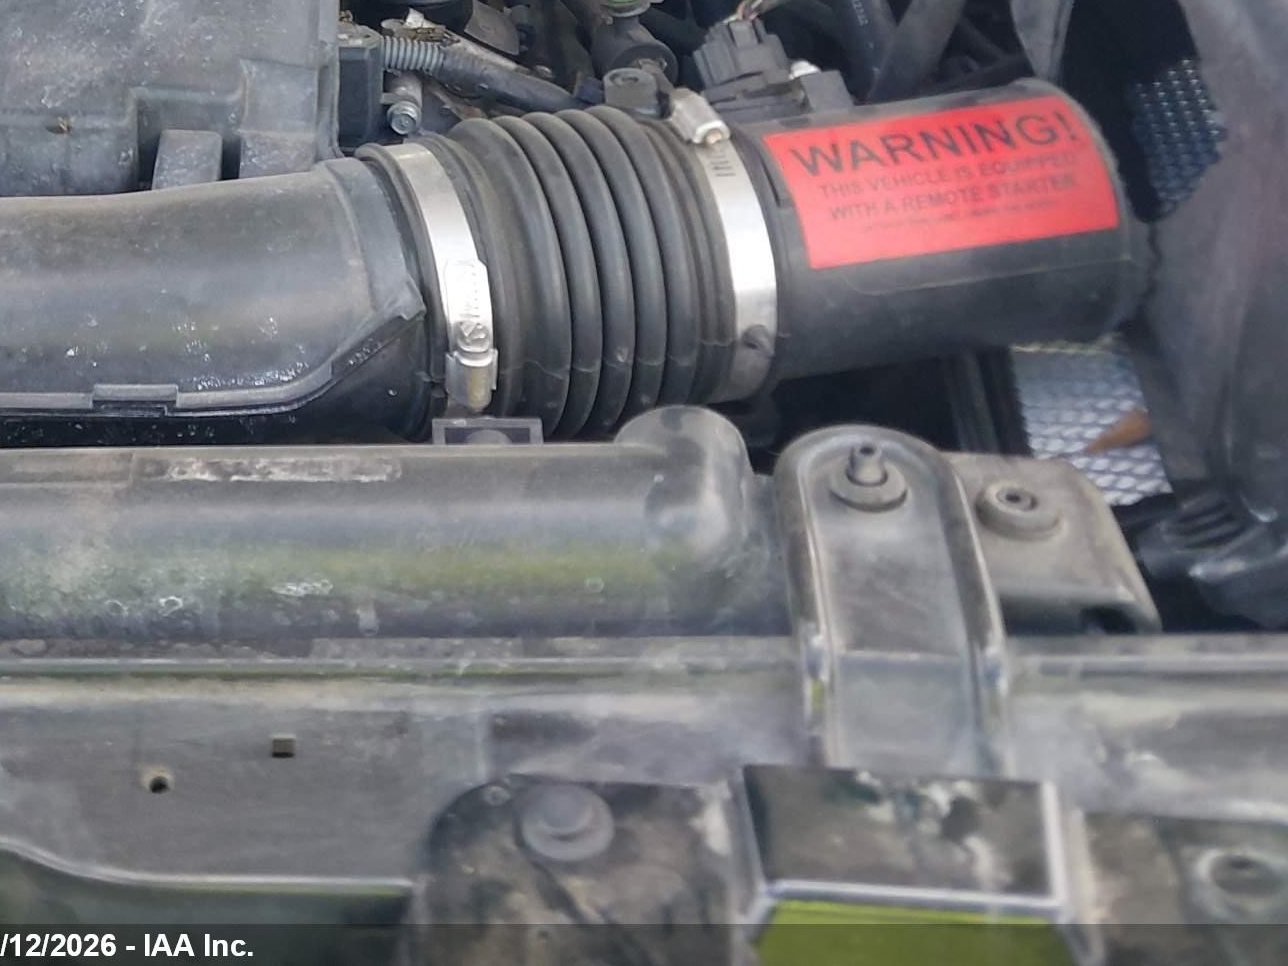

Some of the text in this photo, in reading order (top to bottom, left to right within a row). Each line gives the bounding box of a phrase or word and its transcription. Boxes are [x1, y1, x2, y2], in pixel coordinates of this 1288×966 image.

[792, 112, 1080, 177] WARNING!
[819, 151, 1080, 200] THIS VEHICLE IS EQUIPPED
[829, 199, 880, 220] WITH
[883, 198, 899, 213] A
[902, 185, 984, 212] REMOTE
